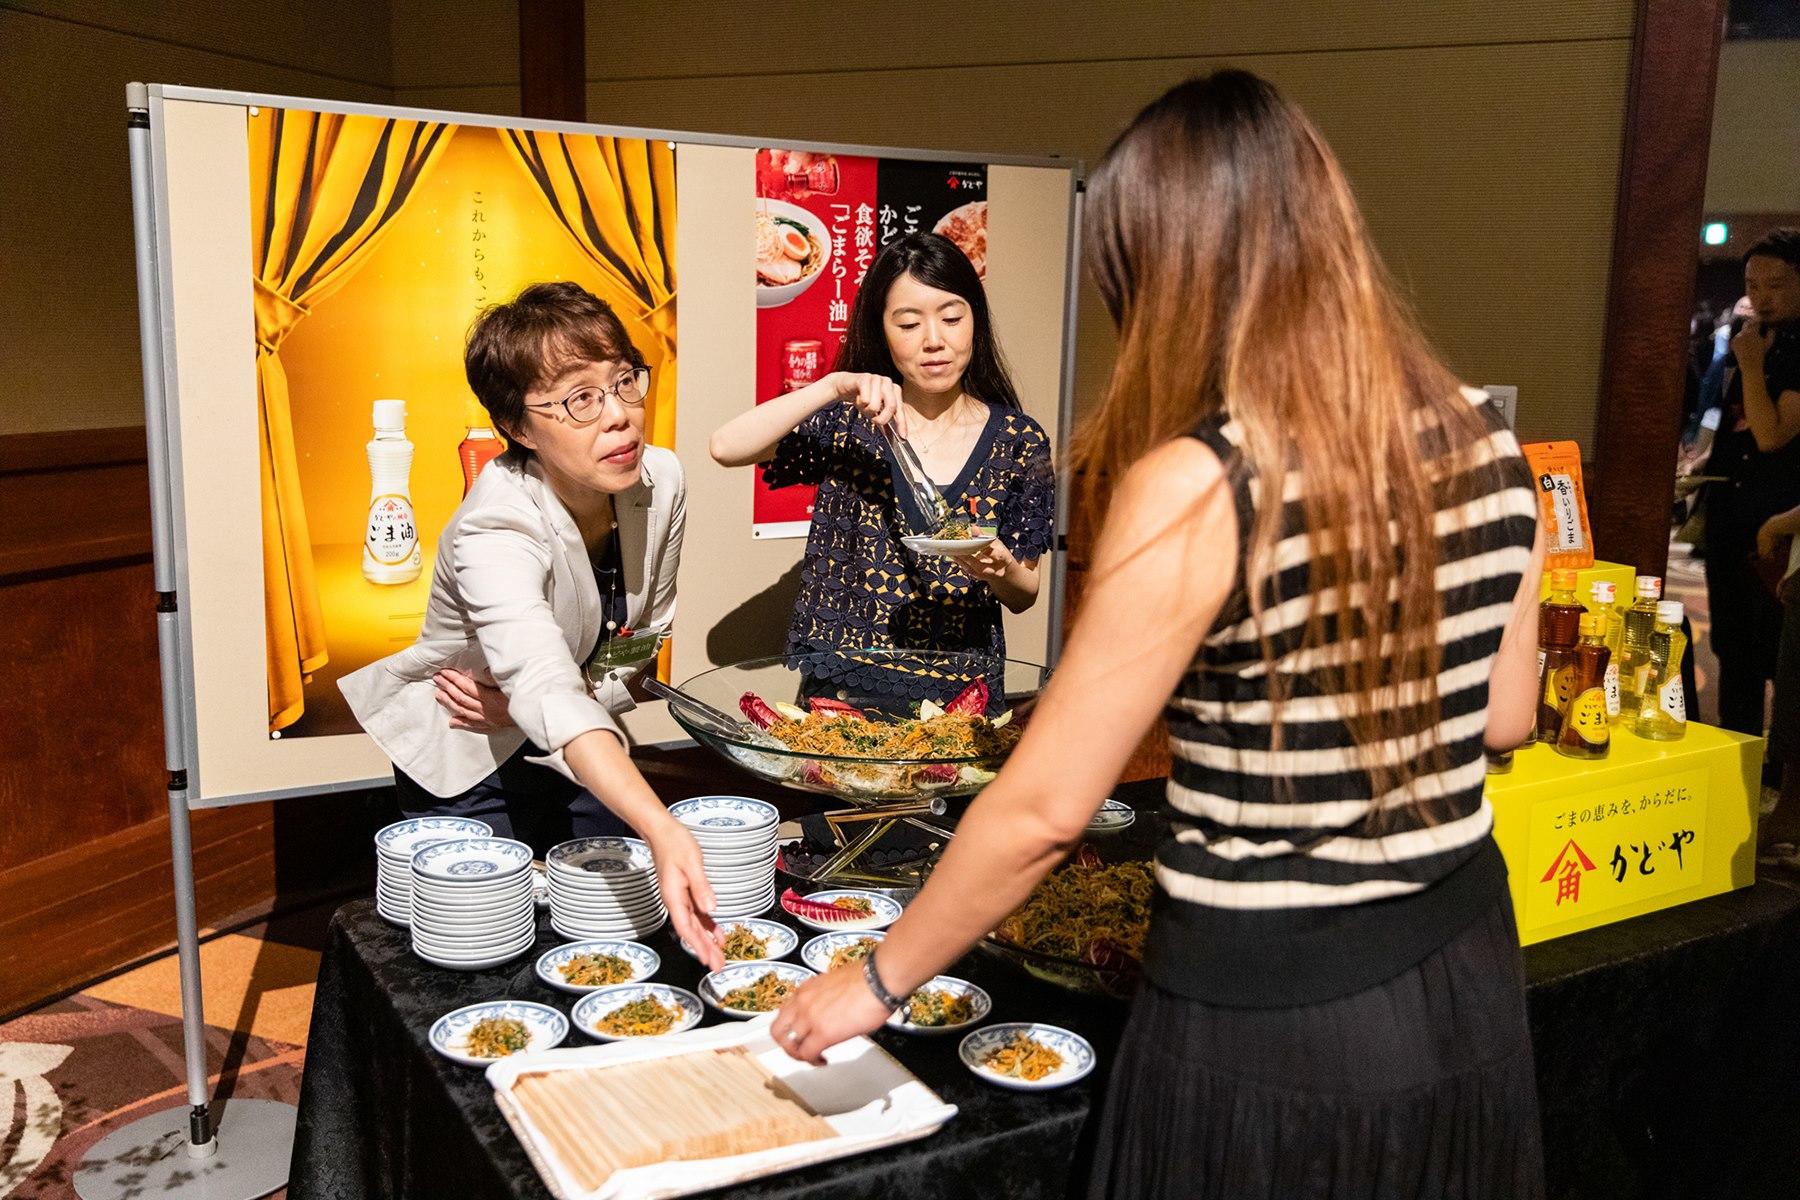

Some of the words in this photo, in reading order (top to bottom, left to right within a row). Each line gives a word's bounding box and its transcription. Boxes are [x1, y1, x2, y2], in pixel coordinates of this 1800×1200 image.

[369, 522, 414, 542] ごま油
[1554, 786, 1692, 830] ごまの恵みを、からだに。
[1609, 828, 1695, 884] かどや
